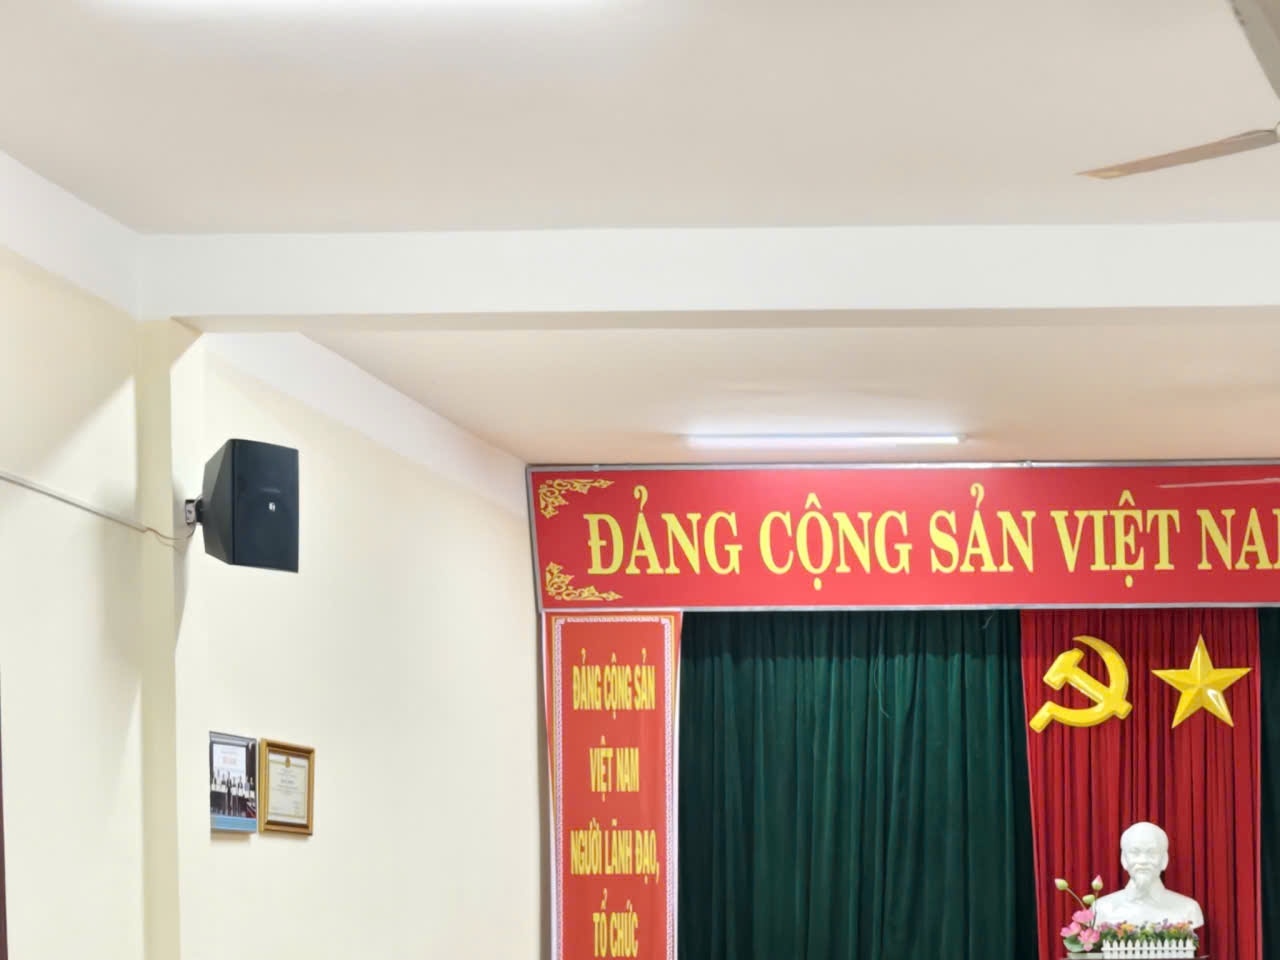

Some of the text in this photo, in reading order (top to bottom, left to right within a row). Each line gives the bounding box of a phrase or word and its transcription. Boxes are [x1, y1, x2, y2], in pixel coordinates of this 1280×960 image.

[584, 485, 742, 575] ĐẢNG
[760, 493, 911, 590] CỘNG
[930, 482, 1036, 573] SẢN
[1051, 491, 1180, 588] VIỆT
[573, 648, 656, 721] ĐẢNG CỘNG SẢN
[589, 736, 639, 802] VIỆT NAM
[604, 818, 632, 875] LÃNH
[593, 888, 639, 958] TỔ CHỨC
